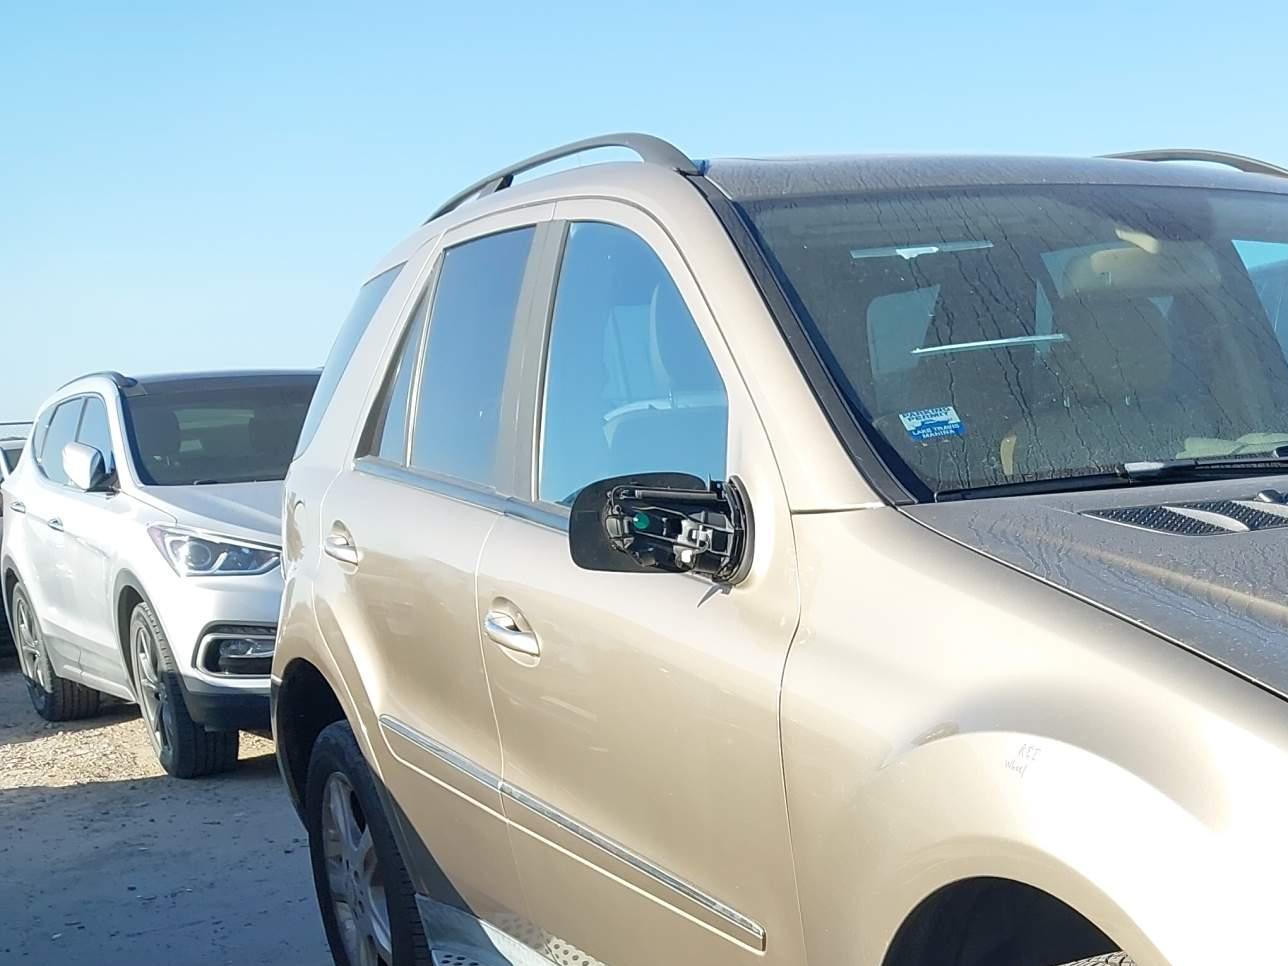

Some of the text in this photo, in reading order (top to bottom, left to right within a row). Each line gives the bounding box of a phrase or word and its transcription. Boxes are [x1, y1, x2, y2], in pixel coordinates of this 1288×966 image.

[908, 412, 947, 421] PERMIT
[912, 424, 960, 436] LAKE TRAVIS
